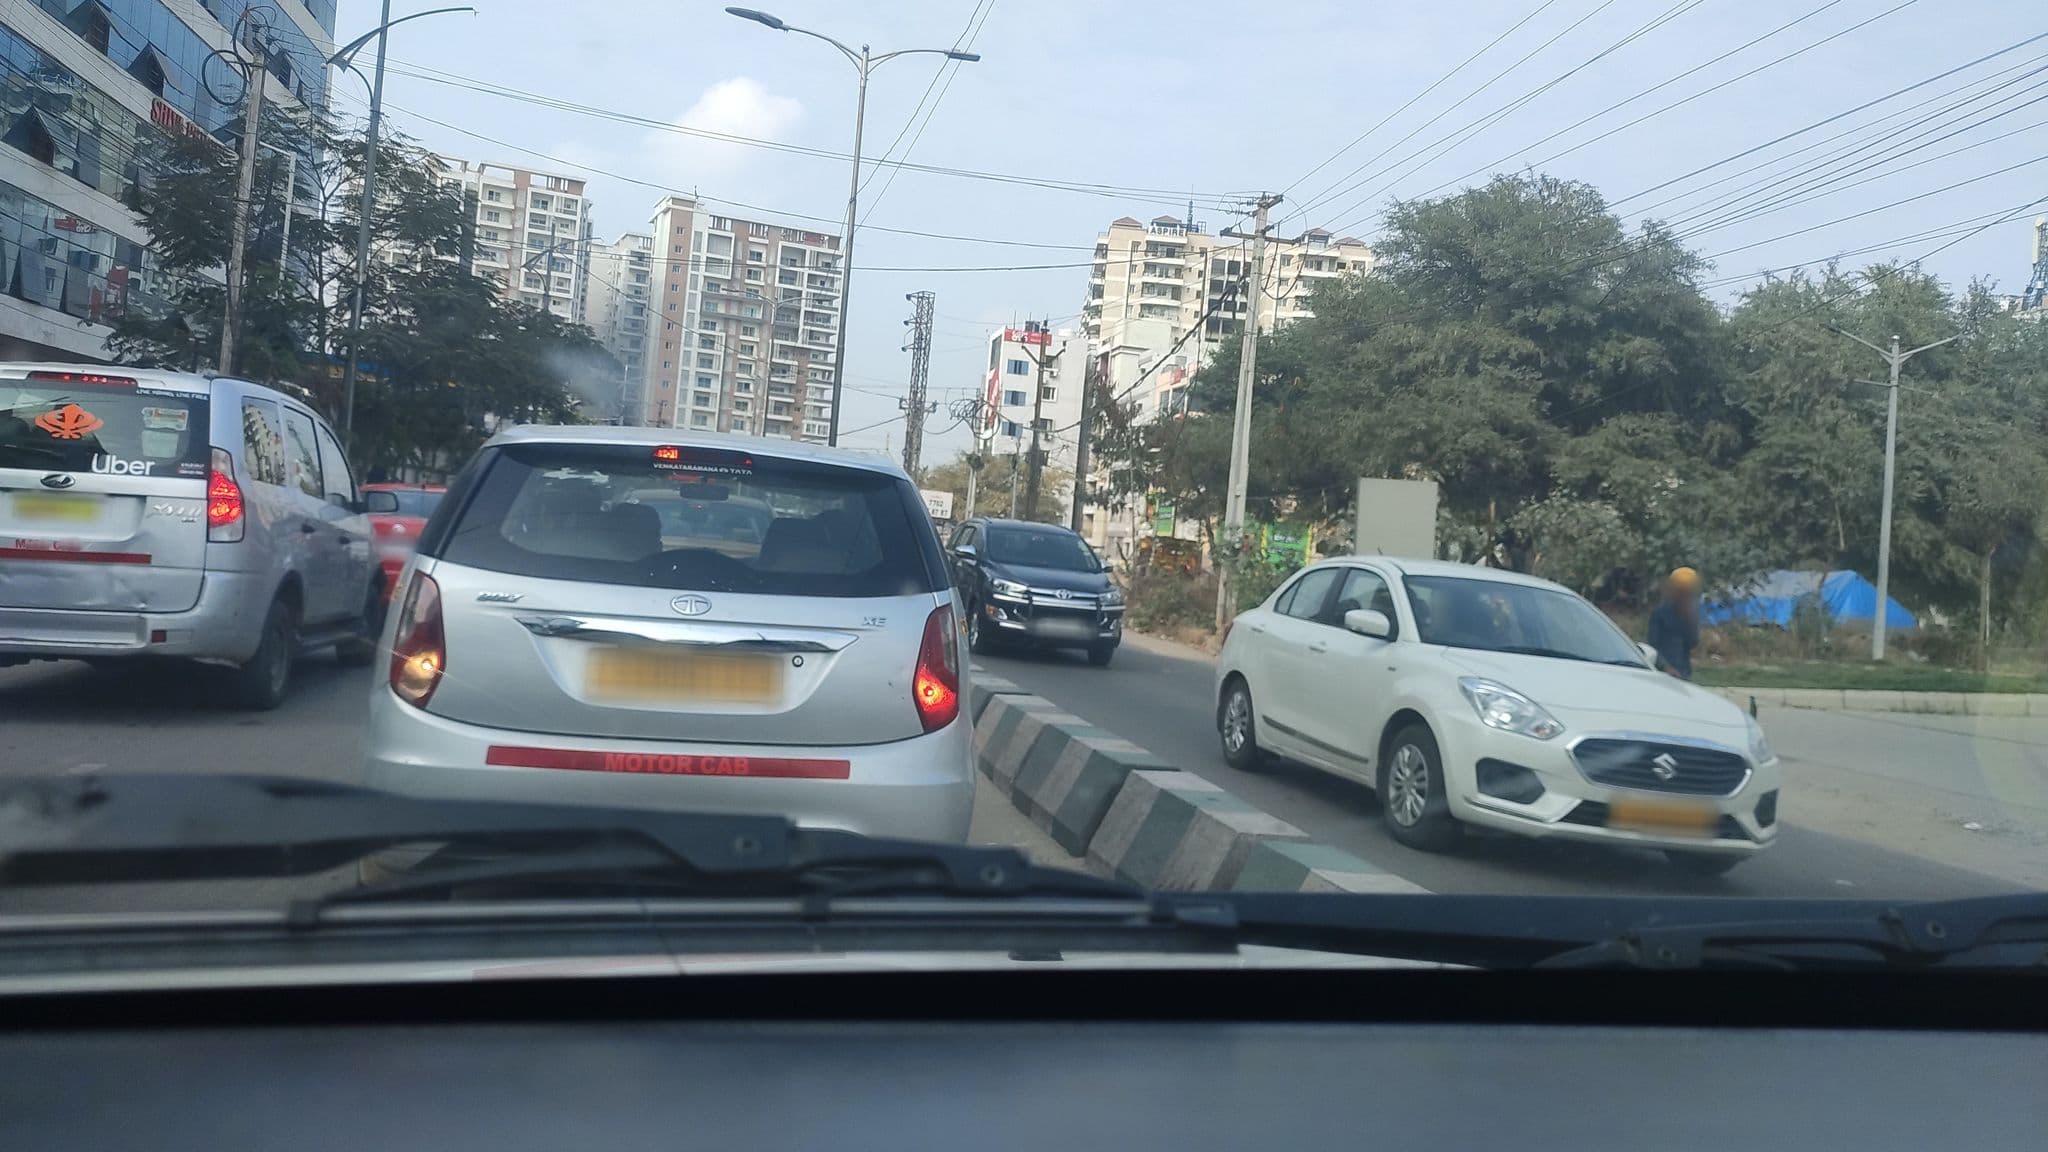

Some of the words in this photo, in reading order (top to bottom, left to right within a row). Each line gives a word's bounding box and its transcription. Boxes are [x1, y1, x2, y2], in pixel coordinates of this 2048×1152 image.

[1150, 226, 1185, 237] ASPIRE
[91, 453, 156, 476] Uber
[730, 467, 753, 475] TATA
[863, 616, 888, 627] XE
[604, 752, 692, 773] MOTOR
[701, 757, 749, 775] CAB
